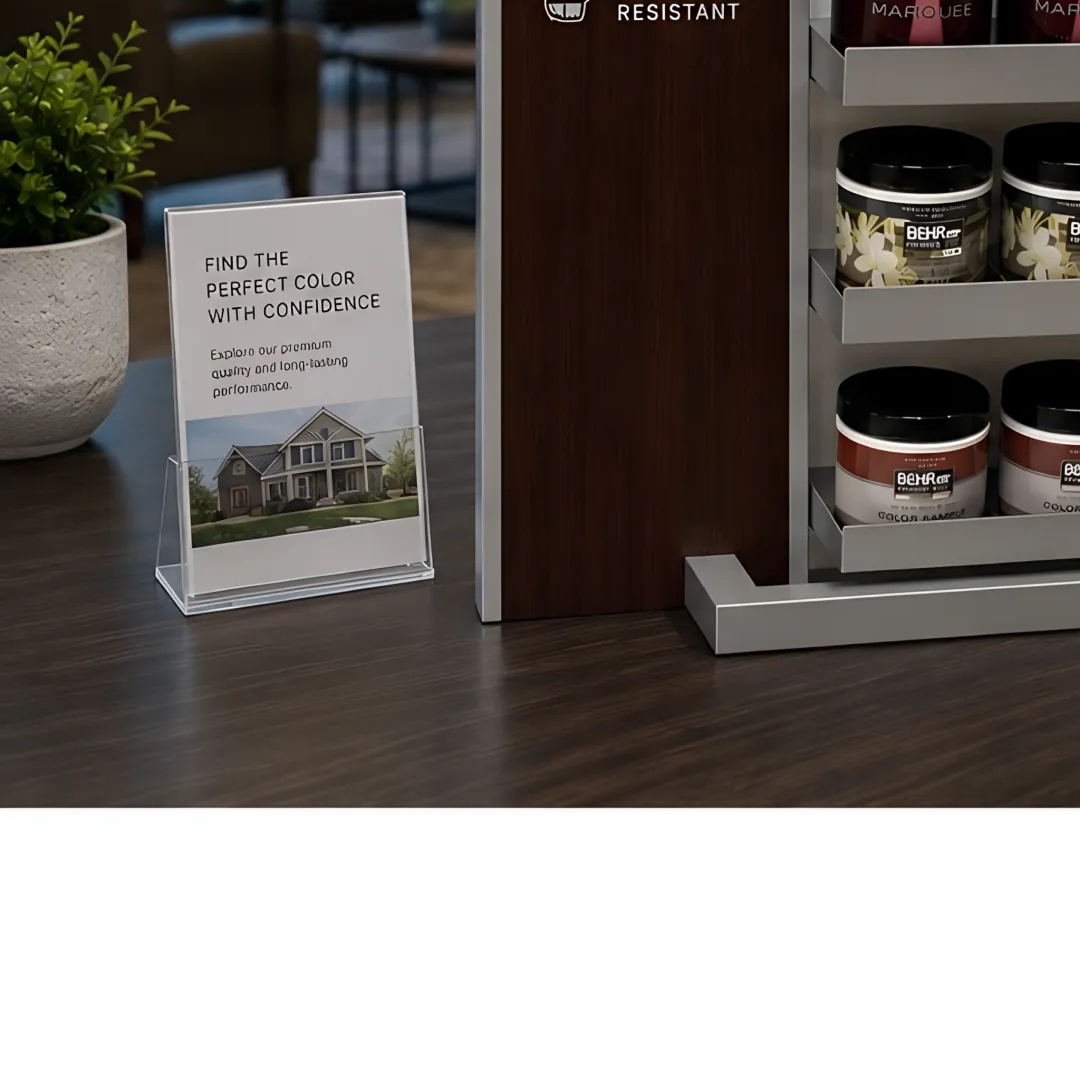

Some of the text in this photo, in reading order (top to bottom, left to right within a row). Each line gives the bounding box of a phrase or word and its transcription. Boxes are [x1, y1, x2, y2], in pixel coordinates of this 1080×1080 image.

[618, 3, 740, 21] RESISTANT
[906, 225, 946, 240] BEHR
[205, 250, 289, 273] FIND THE
[206, 270, 356, 299] PERFECT COLOR
[207, 293, 381, 324] WITH CONFIDENCE
[897, 472, 936, 486] BEHR
